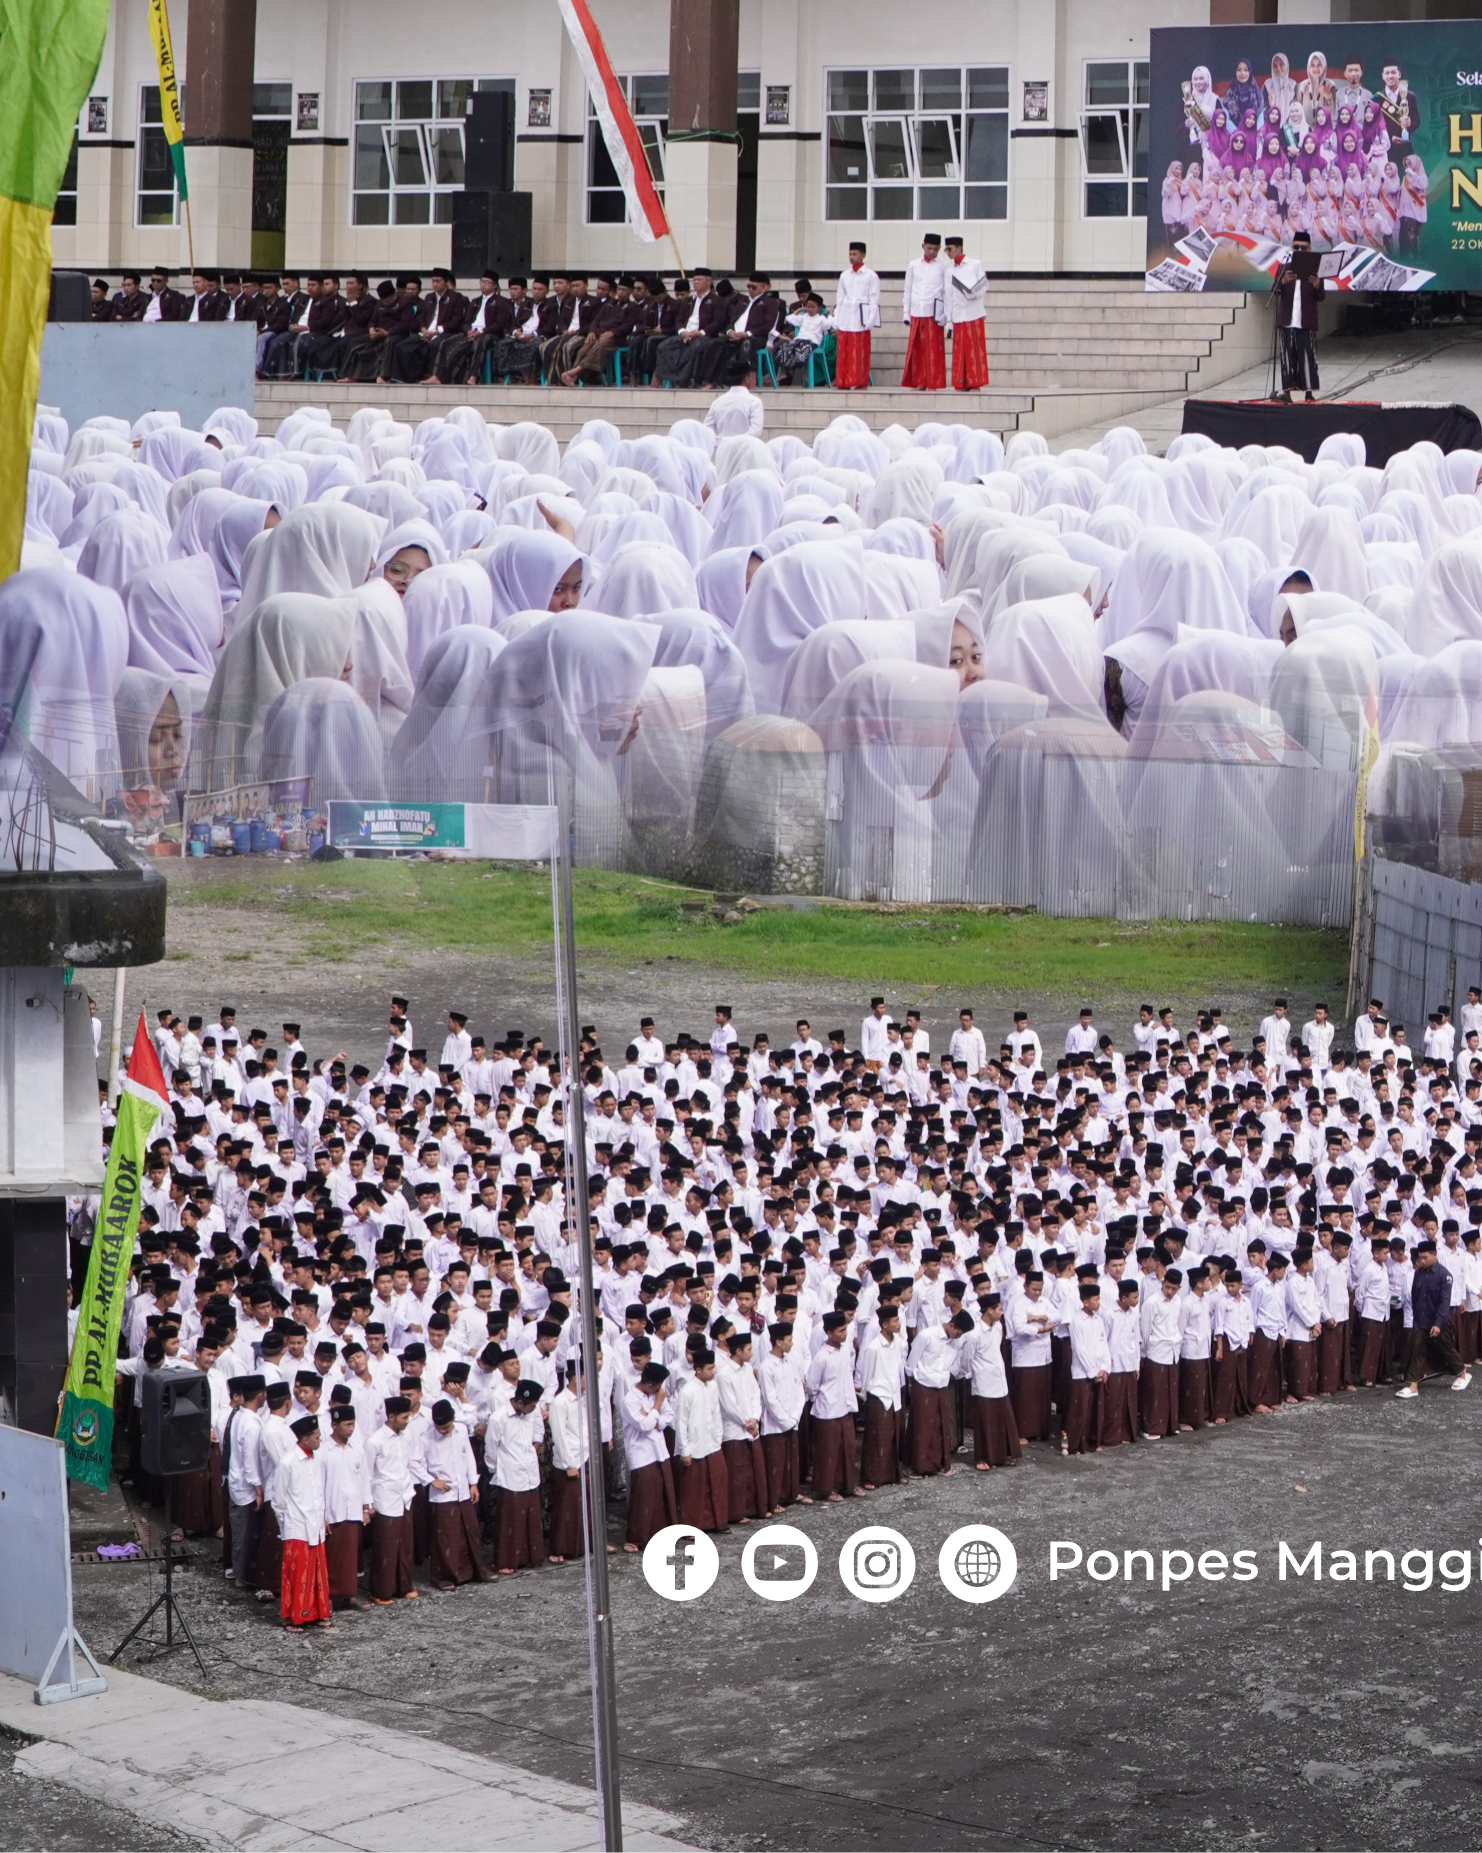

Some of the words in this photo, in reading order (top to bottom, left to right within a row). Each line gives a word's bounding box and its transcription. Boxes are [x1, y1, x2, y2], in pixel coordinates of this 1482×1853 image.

[1451, 239, 1466, 250] 22
[364, 810, 376, 822] AN
[377, 809, 431, 822] NADZHOFATU
[371, 821, 398, 833] MINAL
[400, 822, 424, 834] IMAN
[88, 1154, 138, 1351] AL-MUBAAROK
[83, 1349, 103, 1391] PP
